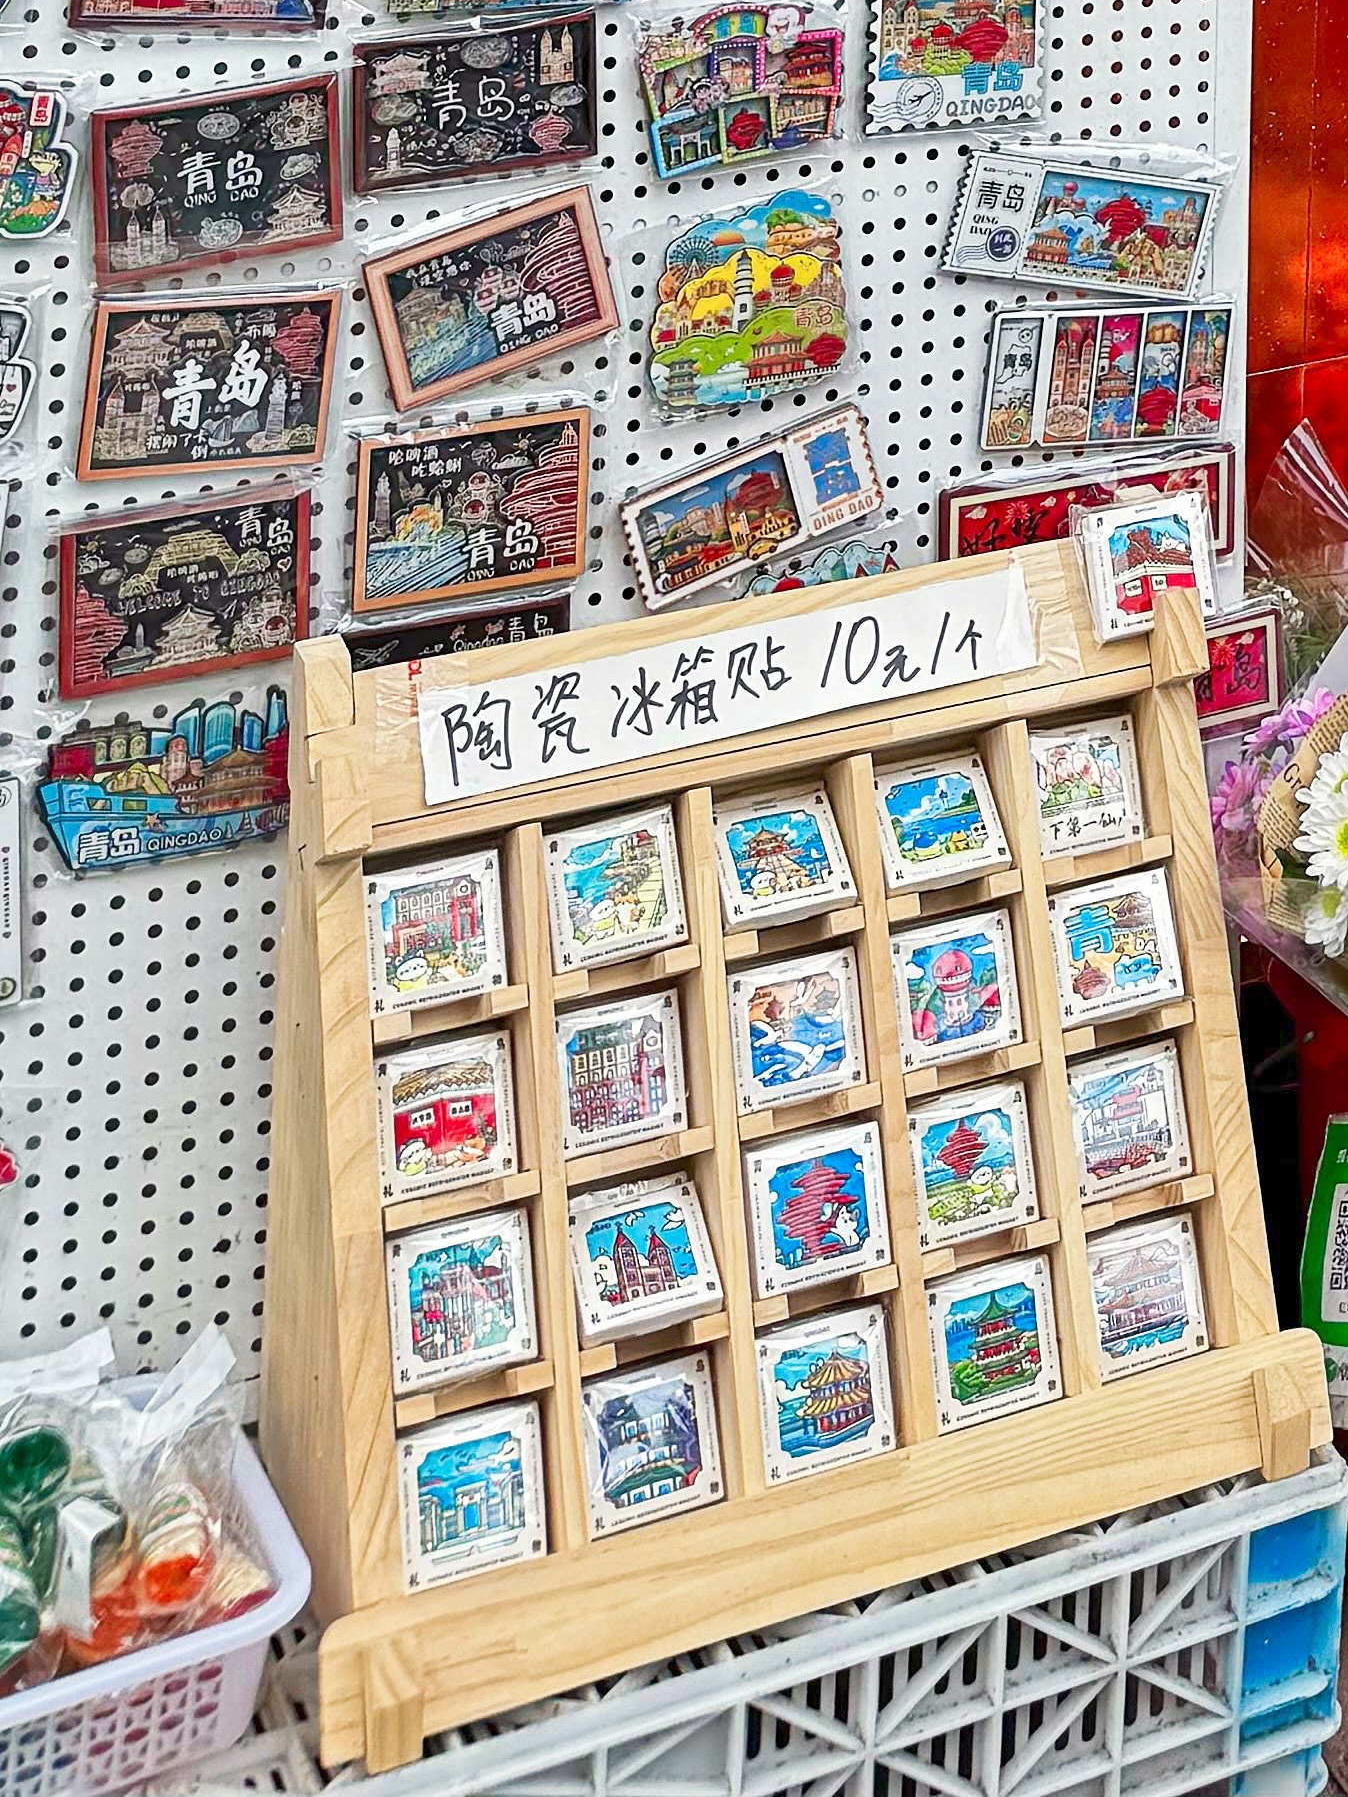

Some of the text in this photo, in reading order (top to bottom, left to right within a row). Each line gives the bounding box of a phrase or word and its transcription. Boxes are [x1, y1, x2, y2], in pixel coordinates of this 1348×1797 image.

[960, 60, 1025, 96] 青岛
[432, 68, 516, 130] 青岛
[945, 95, 1038, 118] QINGDAO
[175, 149, 264, 196] 青岛
[183, 191, 217, 208] QING
[977, 179, 1027, 214] 青岛
[972, 213, 1000, 226] QING
[490, 291, 557, 341] 青岛
[792, 305, 835, 328] 青岛
[162, 339, 269, 430] 青岛
[812, 495, 875, 532] QING DAO
[462, 517, 540, 569] 青岛
[443, 645, 793, 786] 陶瓷冰箱贴
[78, 826, 142, 864] 青岛
[147, 827, 223, 852] QINGDAO
[1063, 905, 1116, 962] 青
